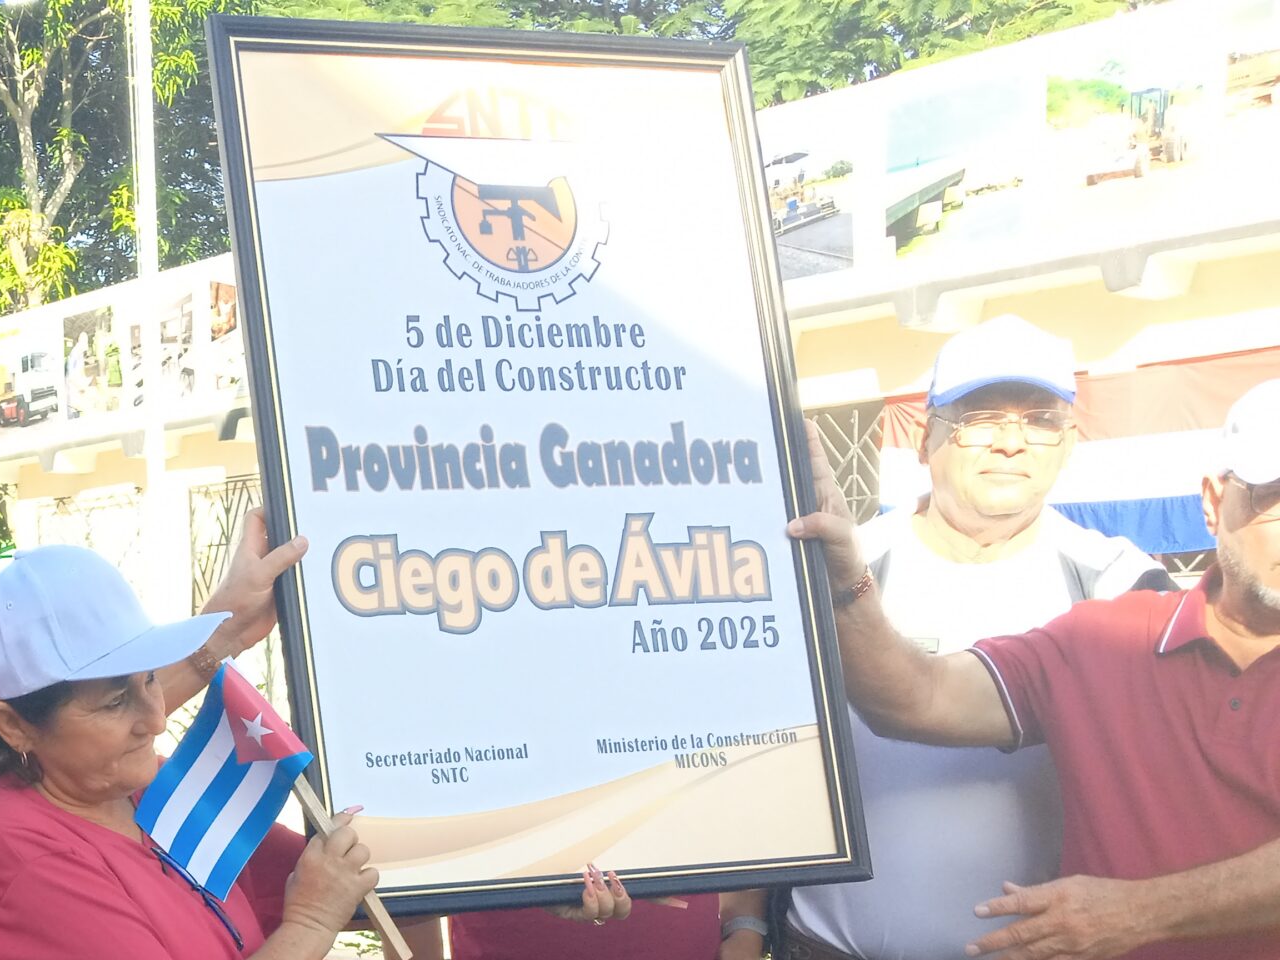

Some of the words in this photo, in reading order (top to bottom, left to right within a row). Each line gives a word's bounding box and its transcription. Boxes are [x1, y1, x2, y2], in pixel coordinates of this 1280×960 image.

[433, 194, 458, 243] SINDICATO
[471, 260, 484, 274] DE
[484, 269, 550, 290] TRABAJADORES
[550, 272, 563, 284] DE
[560, 264, 570, 277] LA
[406, 314, 425, 349] 5
[435, 314, 473, 348] de
[481, 314, 646, 349] Diciembre
[371, 358, 429, 393] Día
[437, 358, 486, 392] del
[495, 358, 687, 392] Constructor
[304, 423, 531, 492] Provincia
[539, 421, 764, 488] Ganadora
[331, 533, 520, 635] Ciego
[523, 529, 608, 611] de
[608, 512, 773, 607] Ávila
[631, 618, 689, 654] Año
[697, 614, 780, 651] 2025
[365, 748, 461, 768] Secretariado
[464, 743, 529, 762] Nacional
[596, 735, 668, 754] Ministerio
[671, 734, 687, 750] de
[690, 733, 704, 749] la
[707, 728, 798, 748] Construcción
[431, 767, 469, 784] SNTC
[674, 751, 728, 769] MICONS
